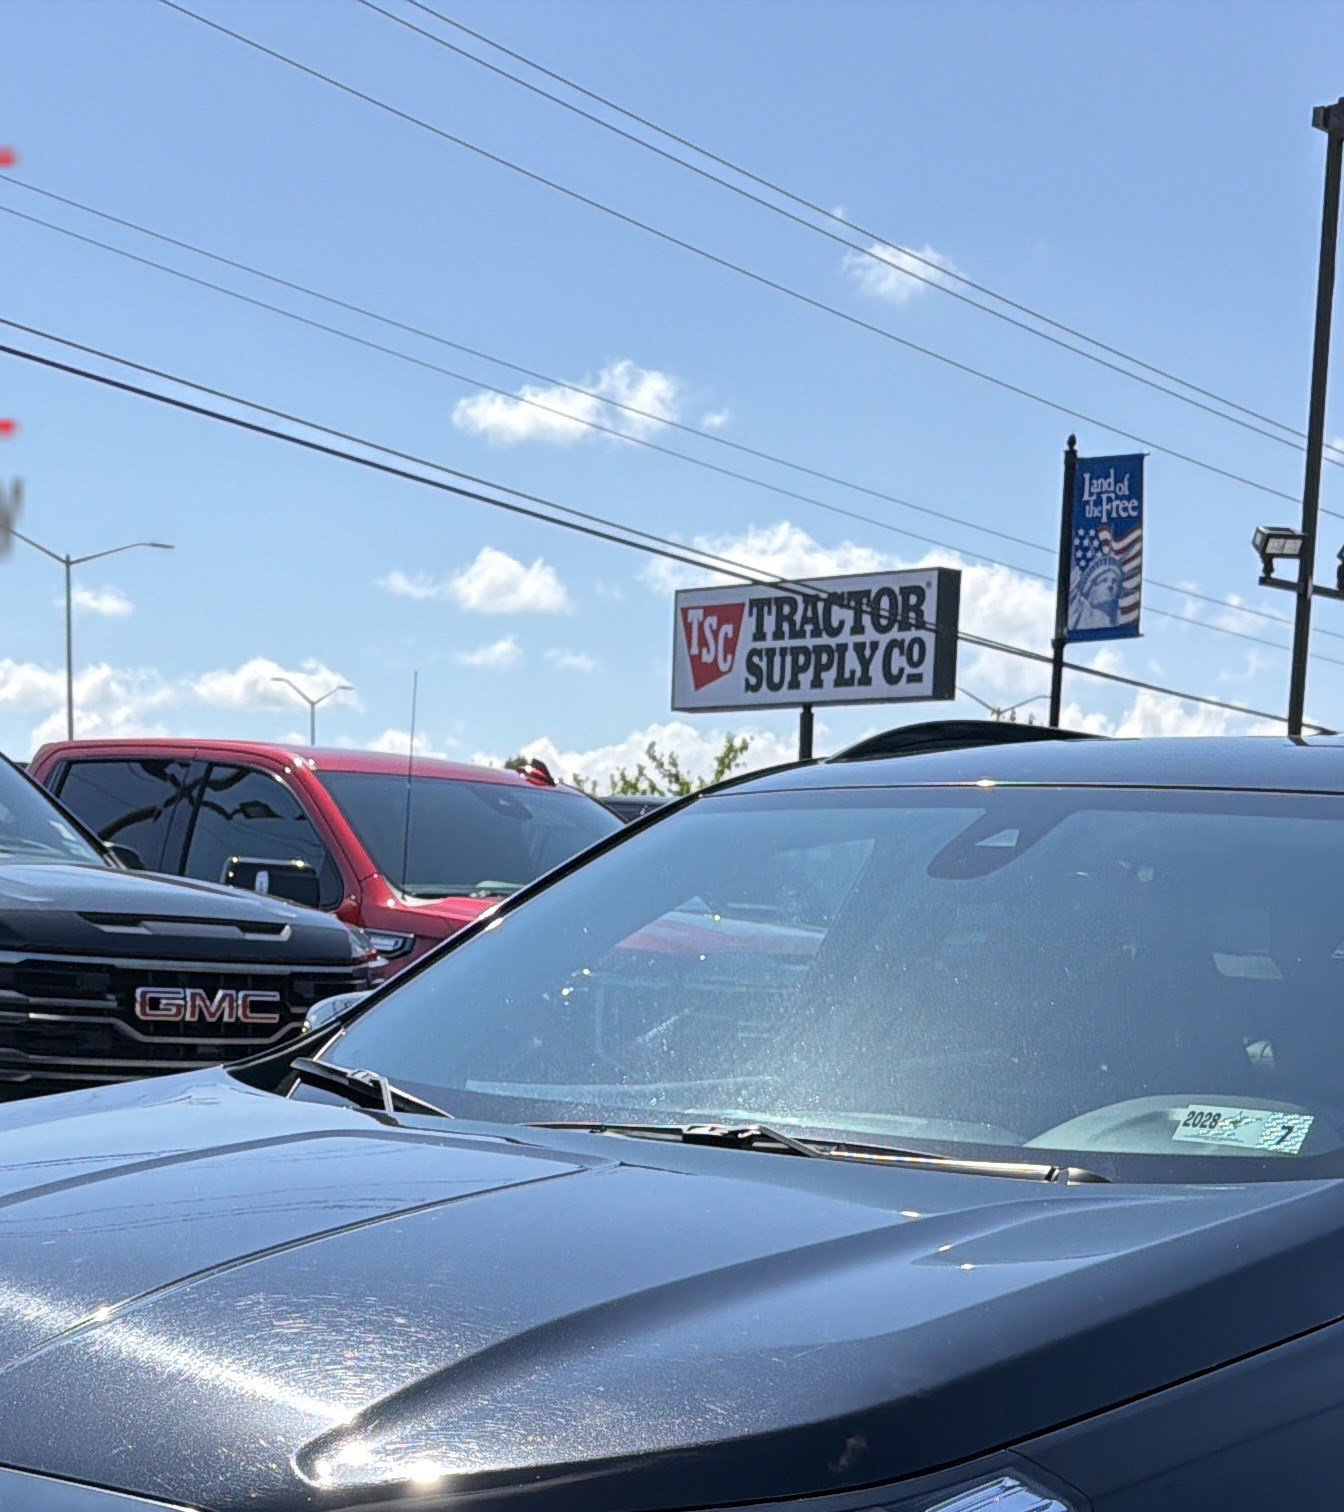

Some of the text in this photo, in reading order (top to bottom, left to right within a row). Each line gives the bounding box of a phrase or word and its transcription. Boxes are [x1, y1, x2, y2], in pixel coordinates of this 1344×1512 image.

[1082, 467, 1130, 501] Land of
[1085, 492, 1139, 522] the Free
[748, 584, 926, 642] TRACTOR
[687, 608, 733, 673] TSC
[745, 641, 879, 693] SUPPLY
[135, 987, 280, 1023] GMC
[1182, 1111, 1222, 1129] 2028
[1276, 1125, 1294, 1145] 7
